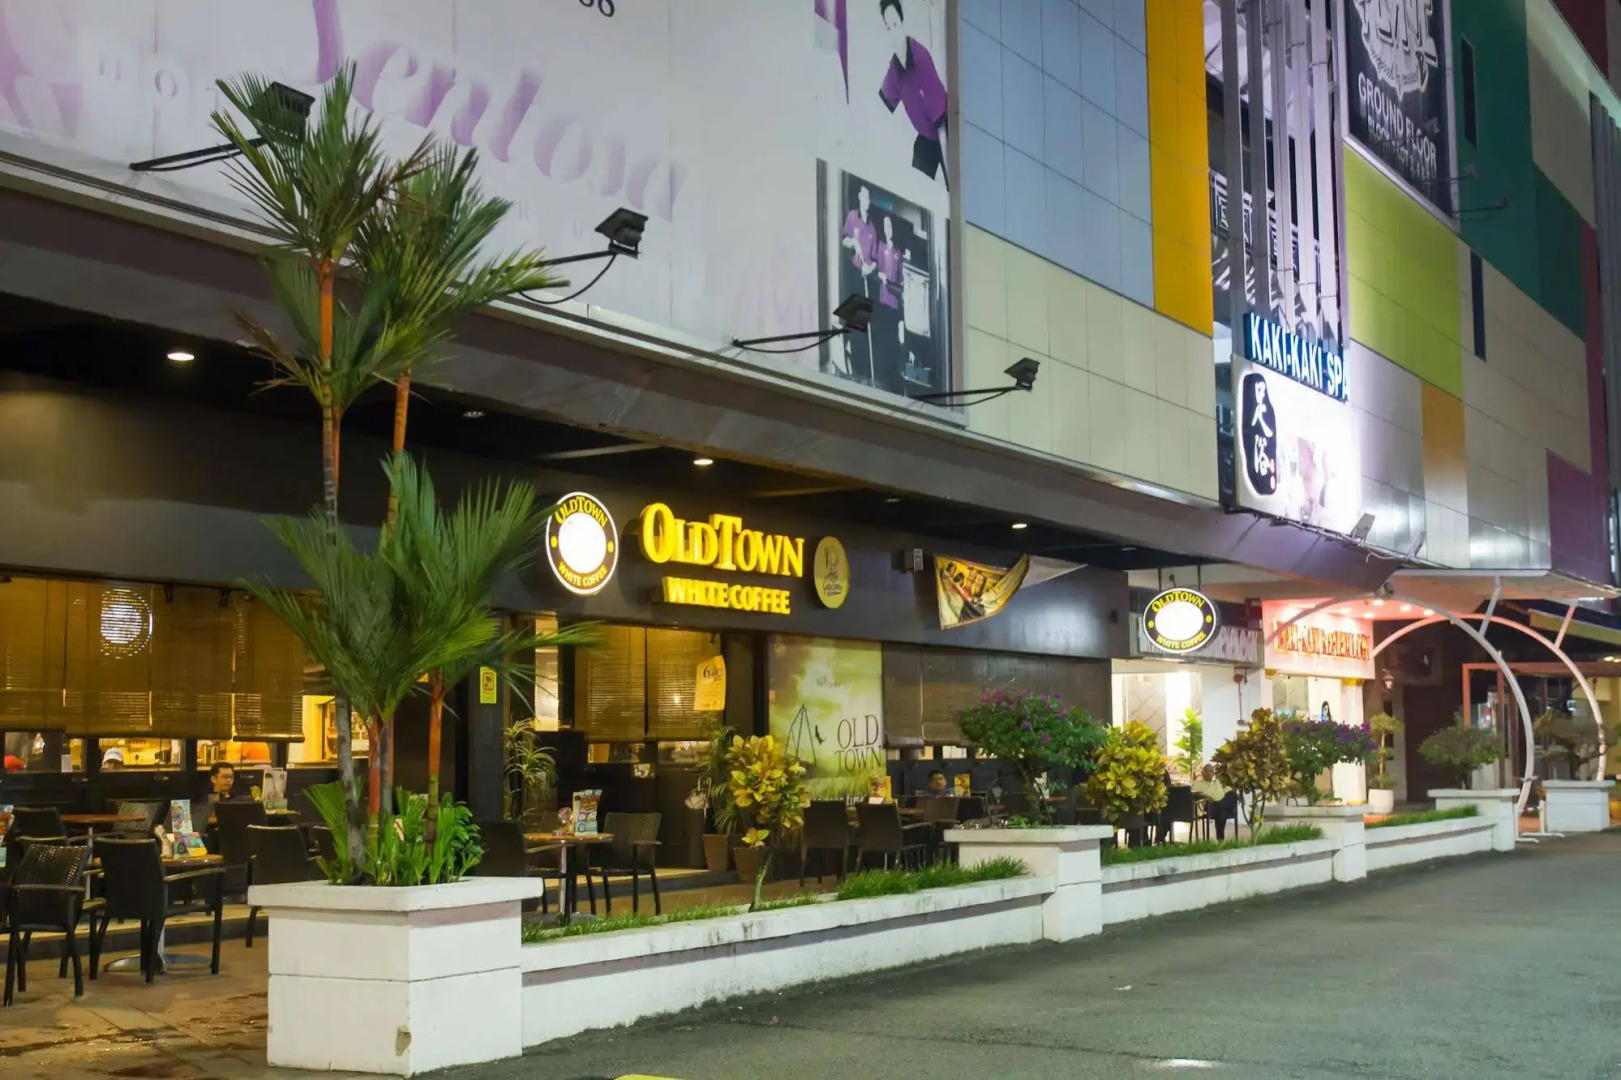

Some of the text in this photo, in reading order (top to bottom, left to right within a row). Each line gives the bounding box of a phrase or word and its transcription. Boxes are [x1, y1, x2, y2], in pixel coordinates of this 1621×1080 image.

[1358, 72, 1404, 133] GROUND
[1405, 116, 1437, 170] FLOOR
[1250, 312, 1350, 400] KAKI-KAKI SPA
[558, 561, 608, 587] WHITE COFFEE
[662, 576, 791, 615] WHITE COFFEE
[1156, 634, 1180, 649] WHITE
[837, 714, 879, 749] OLD
[834, 745, 882, 778] TOWN
